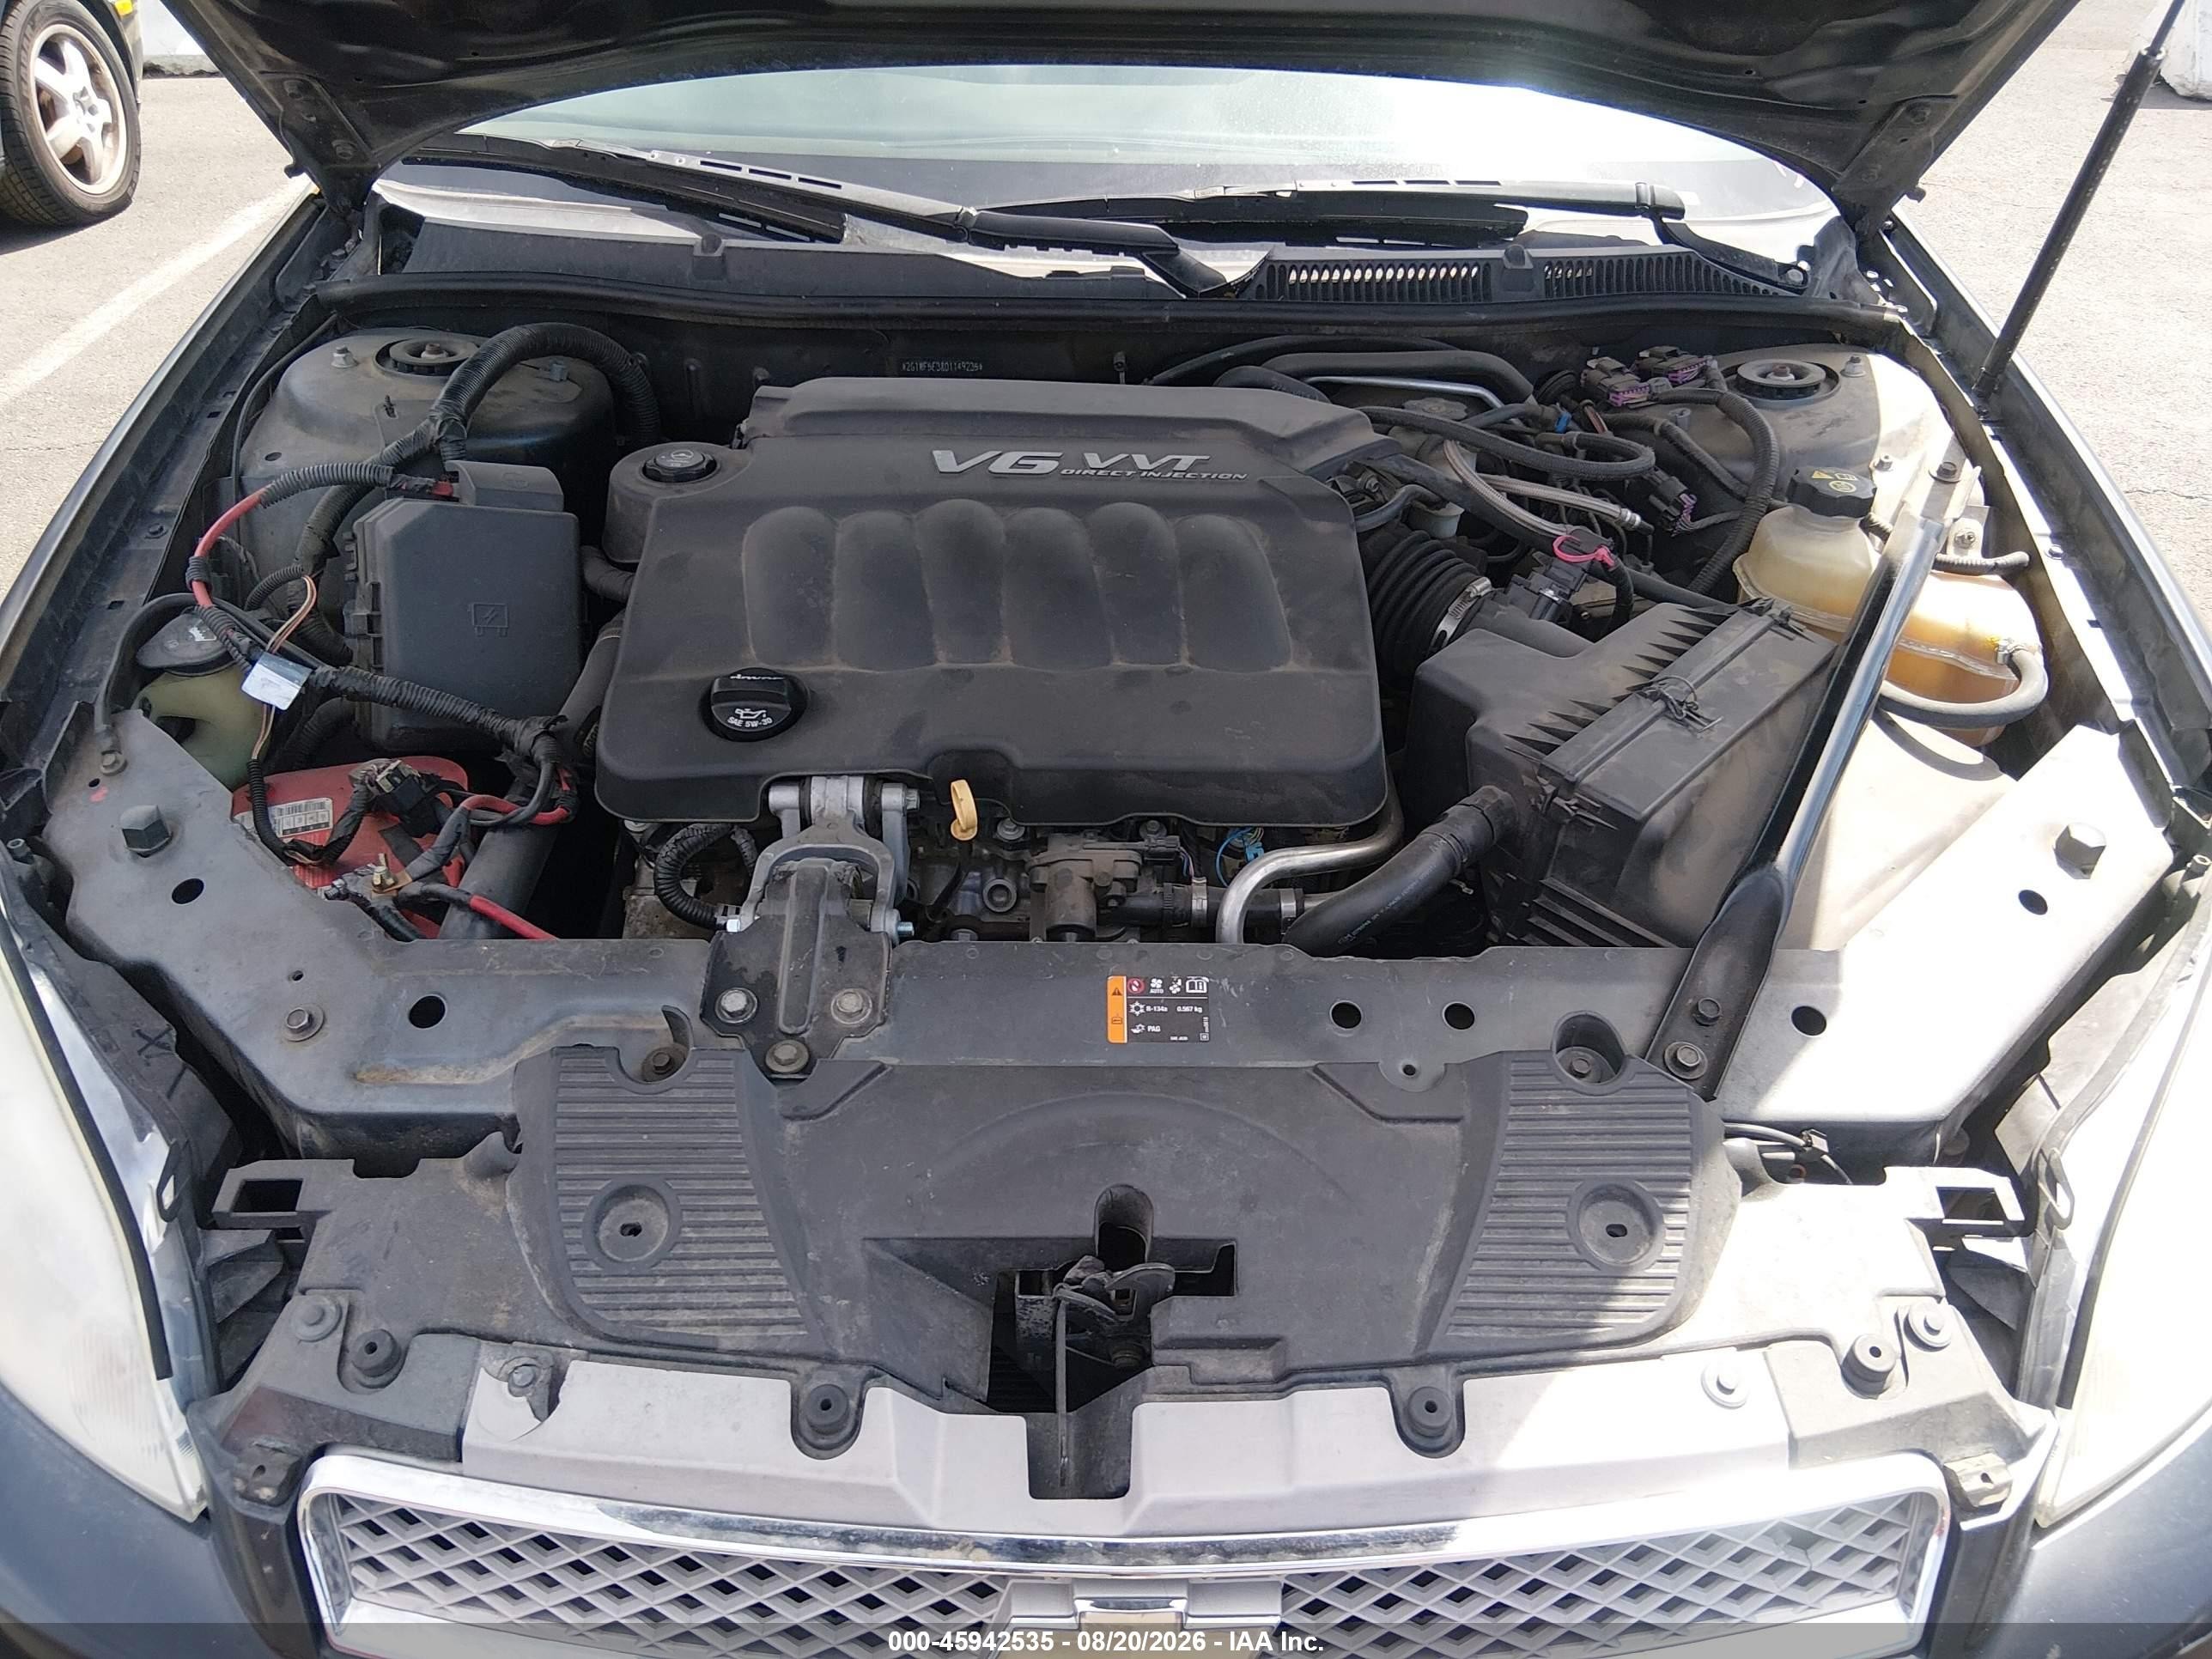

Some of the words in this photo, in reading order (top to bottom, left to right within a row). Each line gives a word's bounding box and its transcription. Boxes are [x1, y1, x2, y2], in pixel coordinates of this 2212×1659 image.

[932, 449, 1063, 475] V6
[1083, 452, 1210, 471] VVT
[1060, 468, 1136, 477] DIRECT
[1139, 470, 1248, 481] INJECTION
[727, 716, 744, 726] SAE
[744, 717, 773, 727] 5W-30
